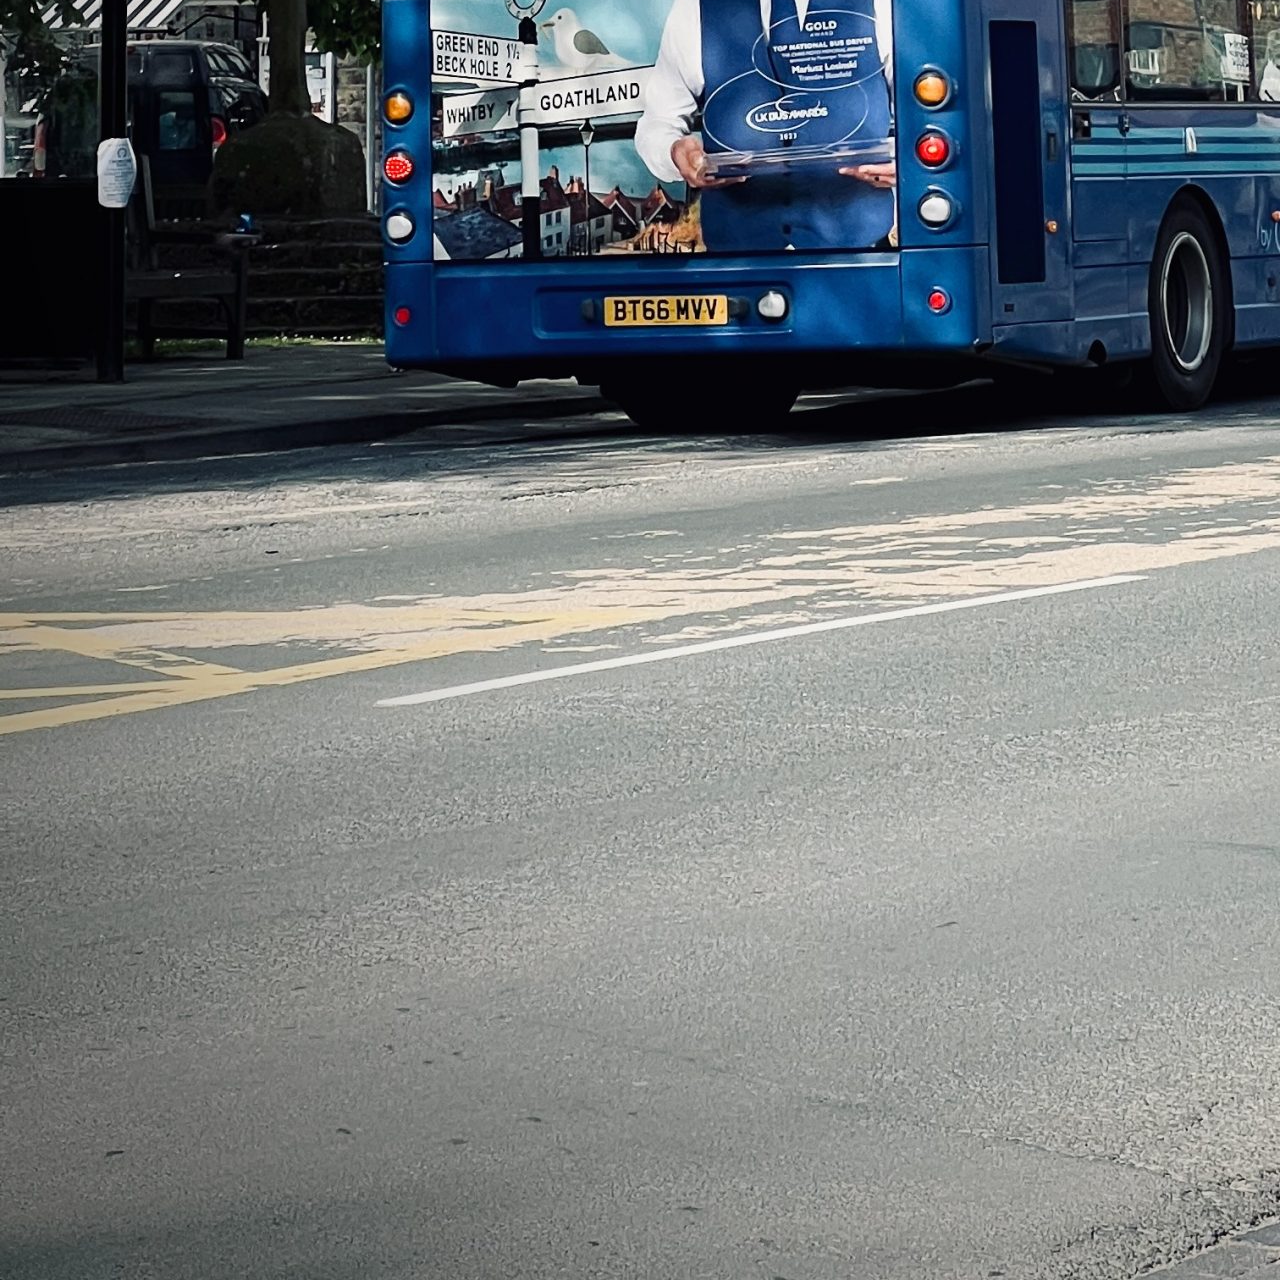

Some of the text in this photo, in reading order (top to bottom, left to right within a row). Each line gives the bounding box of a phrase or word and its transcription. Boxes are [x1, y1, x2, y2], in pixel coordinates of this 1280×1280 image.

[805, 20, 838, 32] GOLD
[436, 33, 474, 55] GREEN
[477, 40, 499, 57] END
[789, 41, 828, 51] NATIONAL
[829, 39, 845, 47] BUS
[845, 37, 873, 46] DRIVER
[436, 54, 512, 79] BECK HOLE 2
[540, 82, 640, 111] GOATHLAND
[446, 103, 495, 124] WHITBY
[1260, 225, 1273, 251] by
[613, 298, 718, 321] BT66 MVV
